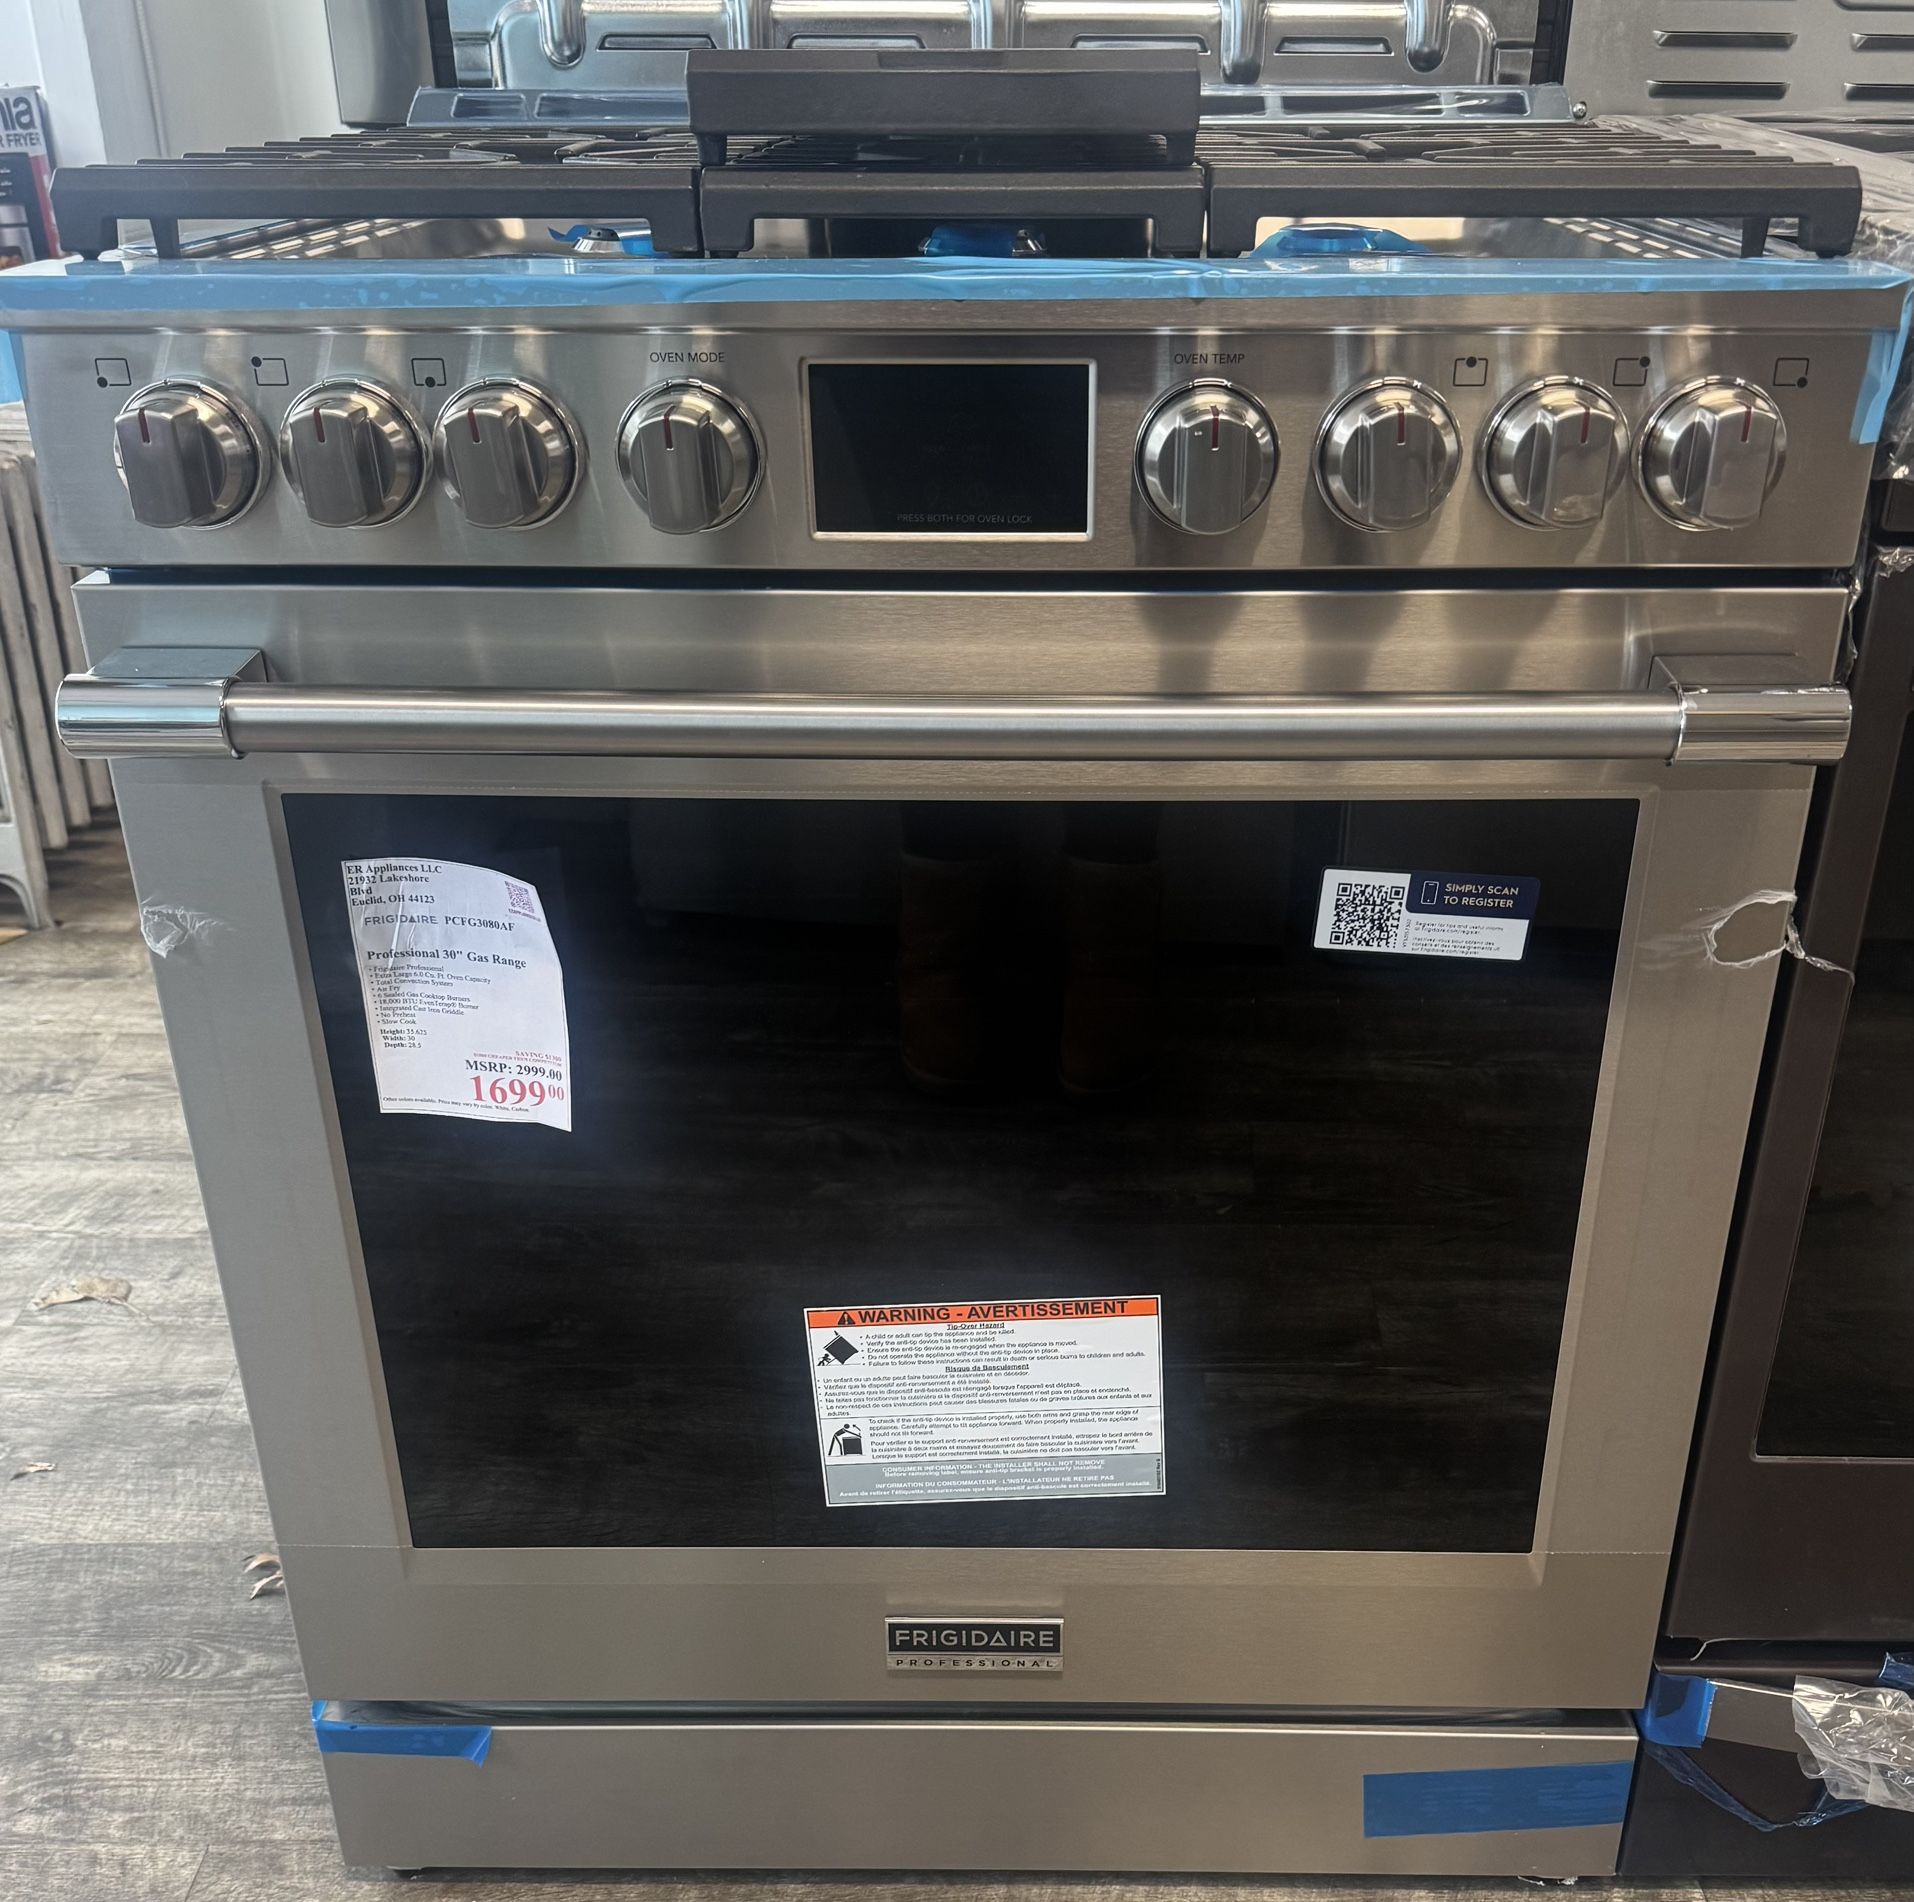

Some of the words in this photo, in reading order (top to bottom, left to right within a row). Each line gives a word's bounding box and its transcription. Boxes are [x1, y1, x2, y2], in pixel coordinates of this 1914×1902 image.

[6, 132, 42, 147] FRYER
[649, 352, 684, 363] OVEN
[687, 352, 725, 363] MODE
[1174, 353, 1208, 364] OVEN
[1211, 353, 1245, 364] TEMP
[897, 513, 924, 522] PRESS
[927, 513, 953, 522] BOTH
[956, 514, 975, 523] FOR
[977, 514, 1005, 523] OVEN
[1007, 514, 1032, 524] LOCK
[347, 865, 363, 874] ER
[366, 863, 418, 875] Appliances
[421, 864, 442, 873] LLC
[349, 875, 376, 885] 21932
[380, 874, 429, 883] Lakeshore
[350, 887, 372, 895] Blvd
[1445, 883, 1485, 894] SIMPLY
[1487, 885, 1519, 896] SCAN
[352, 895, 386, 906] Euclid,
[388, 894, 405, 903] OH
[408, 895, 434, 903] 44123
[1443, 895, 1459, 905] TO
[1461, 896, 1514, 908] REGISTER
[365, 914, 438, 926] FRIGIDAIRE
[445, 916, 515, 932] PCFG3080AF
[367, 947, 440, 961] Professional
[442, 949, 463, 961] 30"
[467, 951, 488, 964] Gas
[492, 954, 527, 969] Range
[447, 973, 464, 981] Oven
[515, 1051, 544, 1059] SAVING
[466, 1060, 512, 1074] MSRP:
[515, 1064, 562, 1082] 2999.00
[470, 1075, 546, 1107] 1699
[548, 1084, 565, 1100] 00
[858, 1307, 949, 1323] WARNING
[966, 1300, 1128, 1318] AVERTISSEMENT
[895, 1630, 1054, 1647] FRIGIDAIRE
[896, 1658, 1053, 1668] PROFESSIONAL
